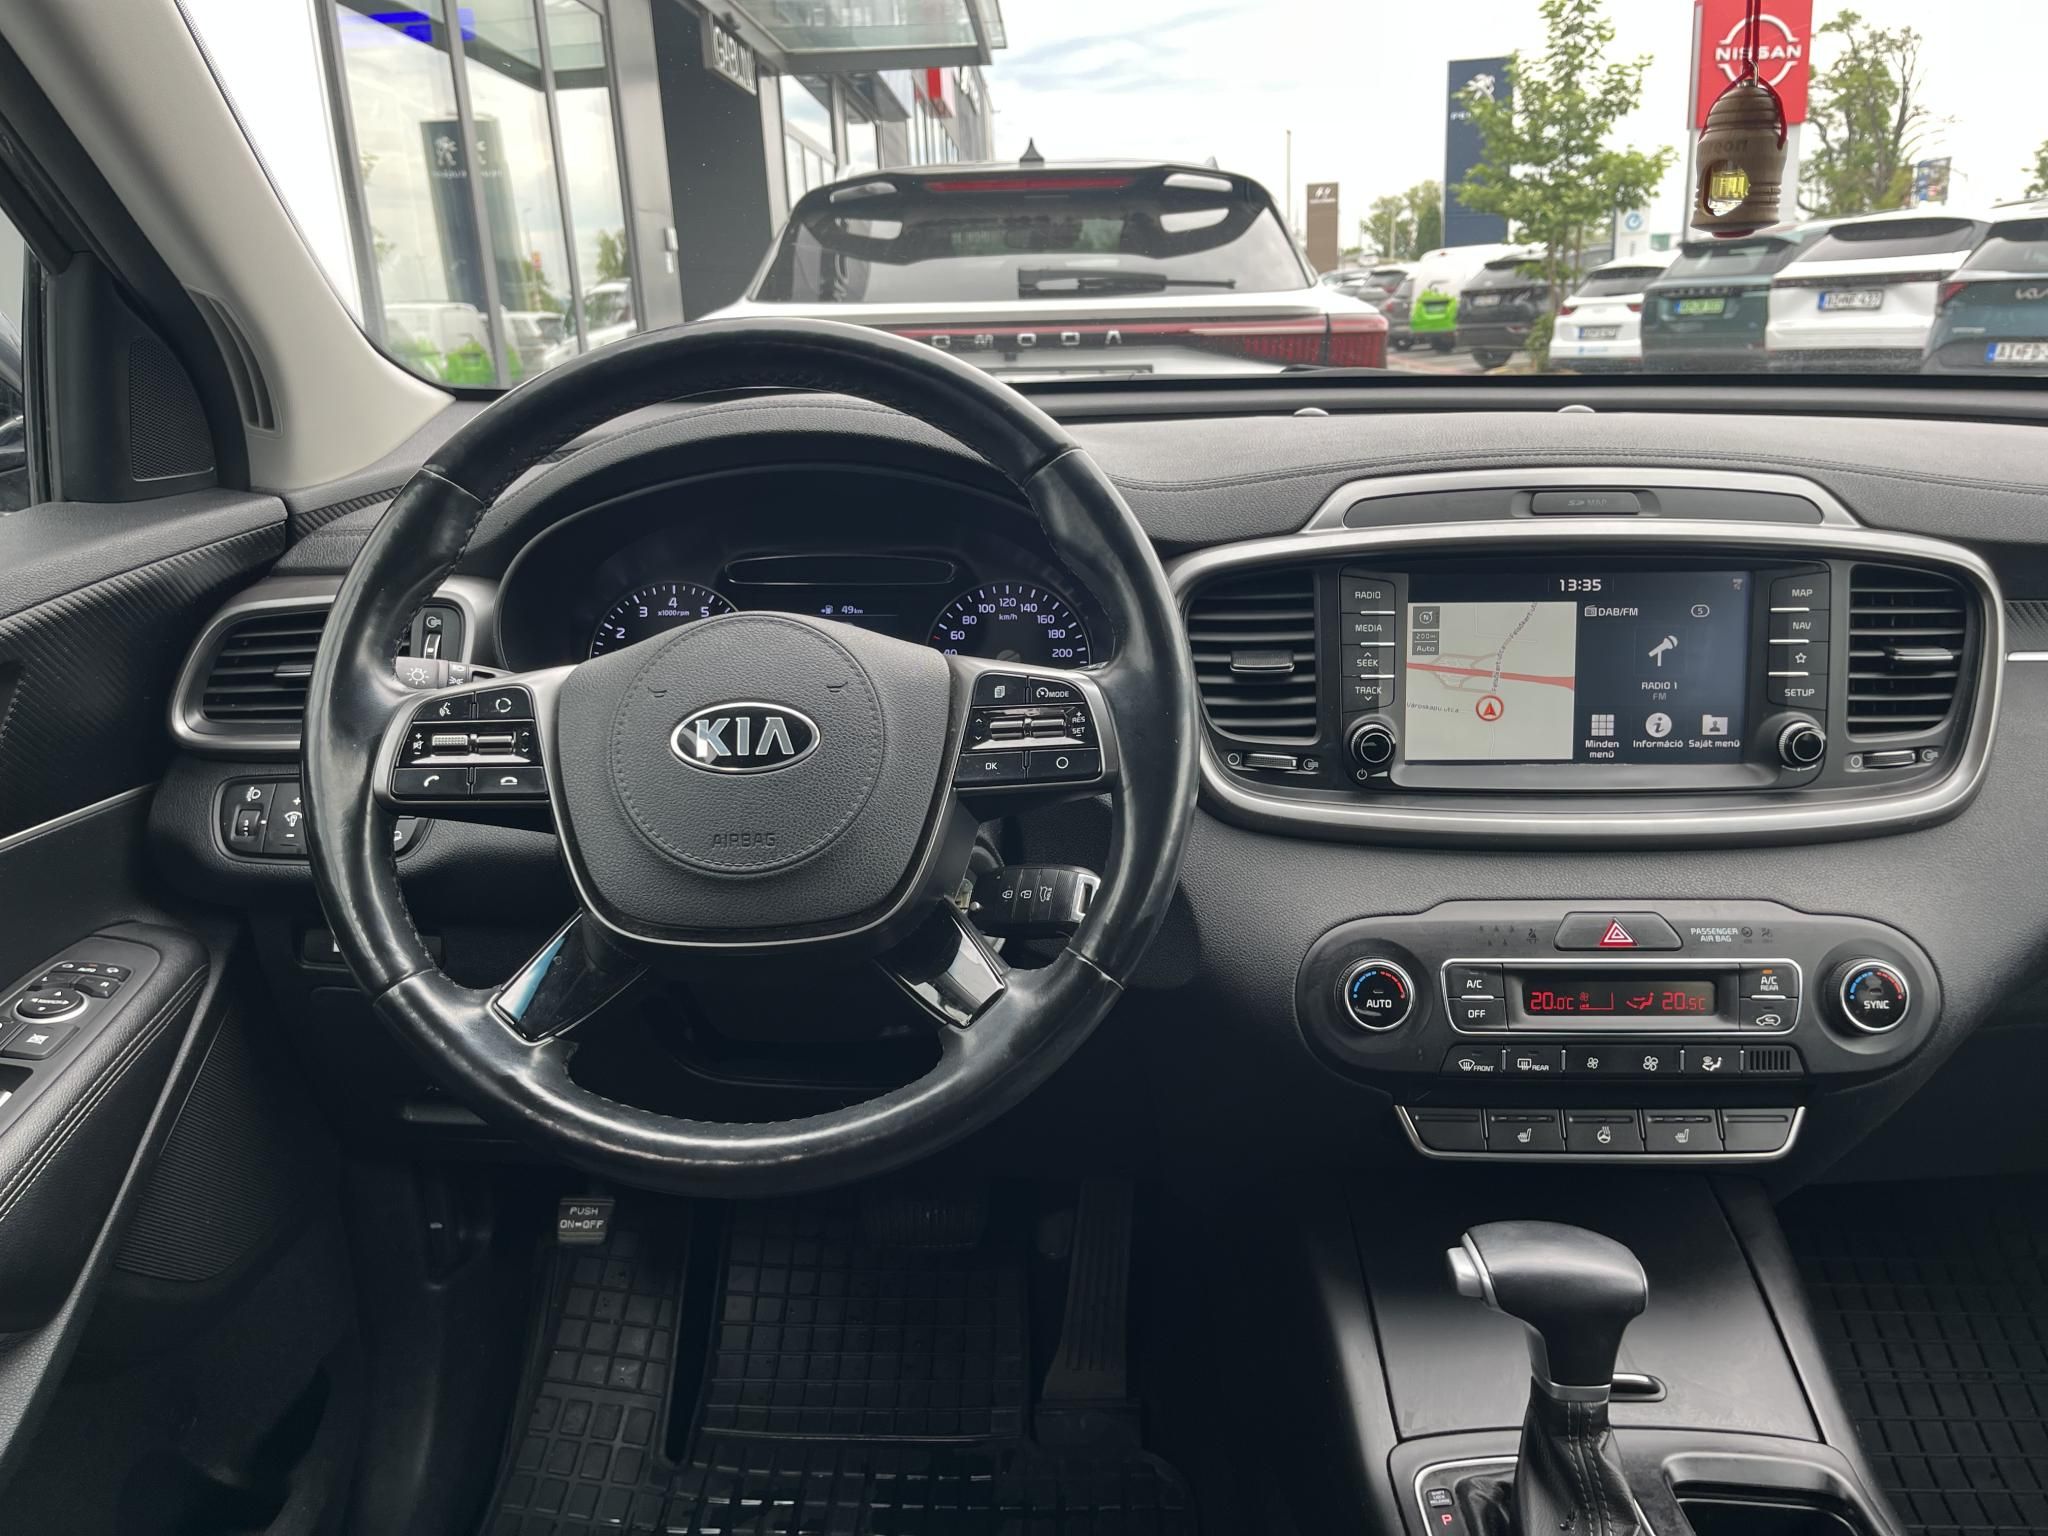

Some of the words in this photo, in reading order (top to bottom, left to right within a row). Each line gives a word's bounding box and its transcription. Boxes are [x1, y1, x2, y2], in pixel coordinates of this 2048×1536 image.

[931, 329, 1122, 349] OMODA
[1559, 578, 1602, 592] 13:35
[1354, 591, 1381, 599] RADIO
[1791, 588, 1813, 598] MAP
[668, 597, 678, 609] 4
[999, 597, 1017, 607] 120
[639, 606, 648, 618] 3
[700, 606, 710, 618] 5
[978, 603, 996, 613] 100
[1020, 603, 1038, 613] 140
[1598, 607, 1638, 617] DAB/FM
[962, 615, 977, 625] 80
[998, 613, 1018, 621] km/h
[1037, 614, 1055, 624] 160
[1355, 624, 1382, 632] MEDIA
[1792, 621, 1811, 630] NAV
[615, 627, 625, 639] 2
[950, 630, 966, 640] 60
[1048, 629, 1066, 639] 180
[1052, 648, 1073, 658] 200
[1356, 659, 1379, 667] SEEK
[1354, 686, 1382, 694] TRACK
[1641, 681, 1671, 691] RADIO
[1652, 693, 1667, 701] FM
[1784, 688, 1815, 698] SETUP
[695, 717, 795, 757] KIA
[1585, 739, 1620, 748] Minden
[1632, 739, 1684, 748] Információ
[1688, 739, 1713, 749] Saját
[985, 762, 998, 770] OK
[711, 832, 776, 849] AIRBAG
[1690, 927, 1739, 936] PASSENGER
[1700, 935, 1714, 943] AIR
[1715, 935, 1732, 943] BAG
[1466, 979, 1482, 989] A/C
[1760, 976, 1777, 985] A/C
[1760, 984, 1779, 992] REAR
[1366, 999, 1392, 1009] AUTO
[1863, 1000, 1890, 1010] SYNC
[1467, 1009, 1486, 1018] OFF
[569, 1206, 599, 1216] PUSH
[1441, 1514, 1453, 1526] P
